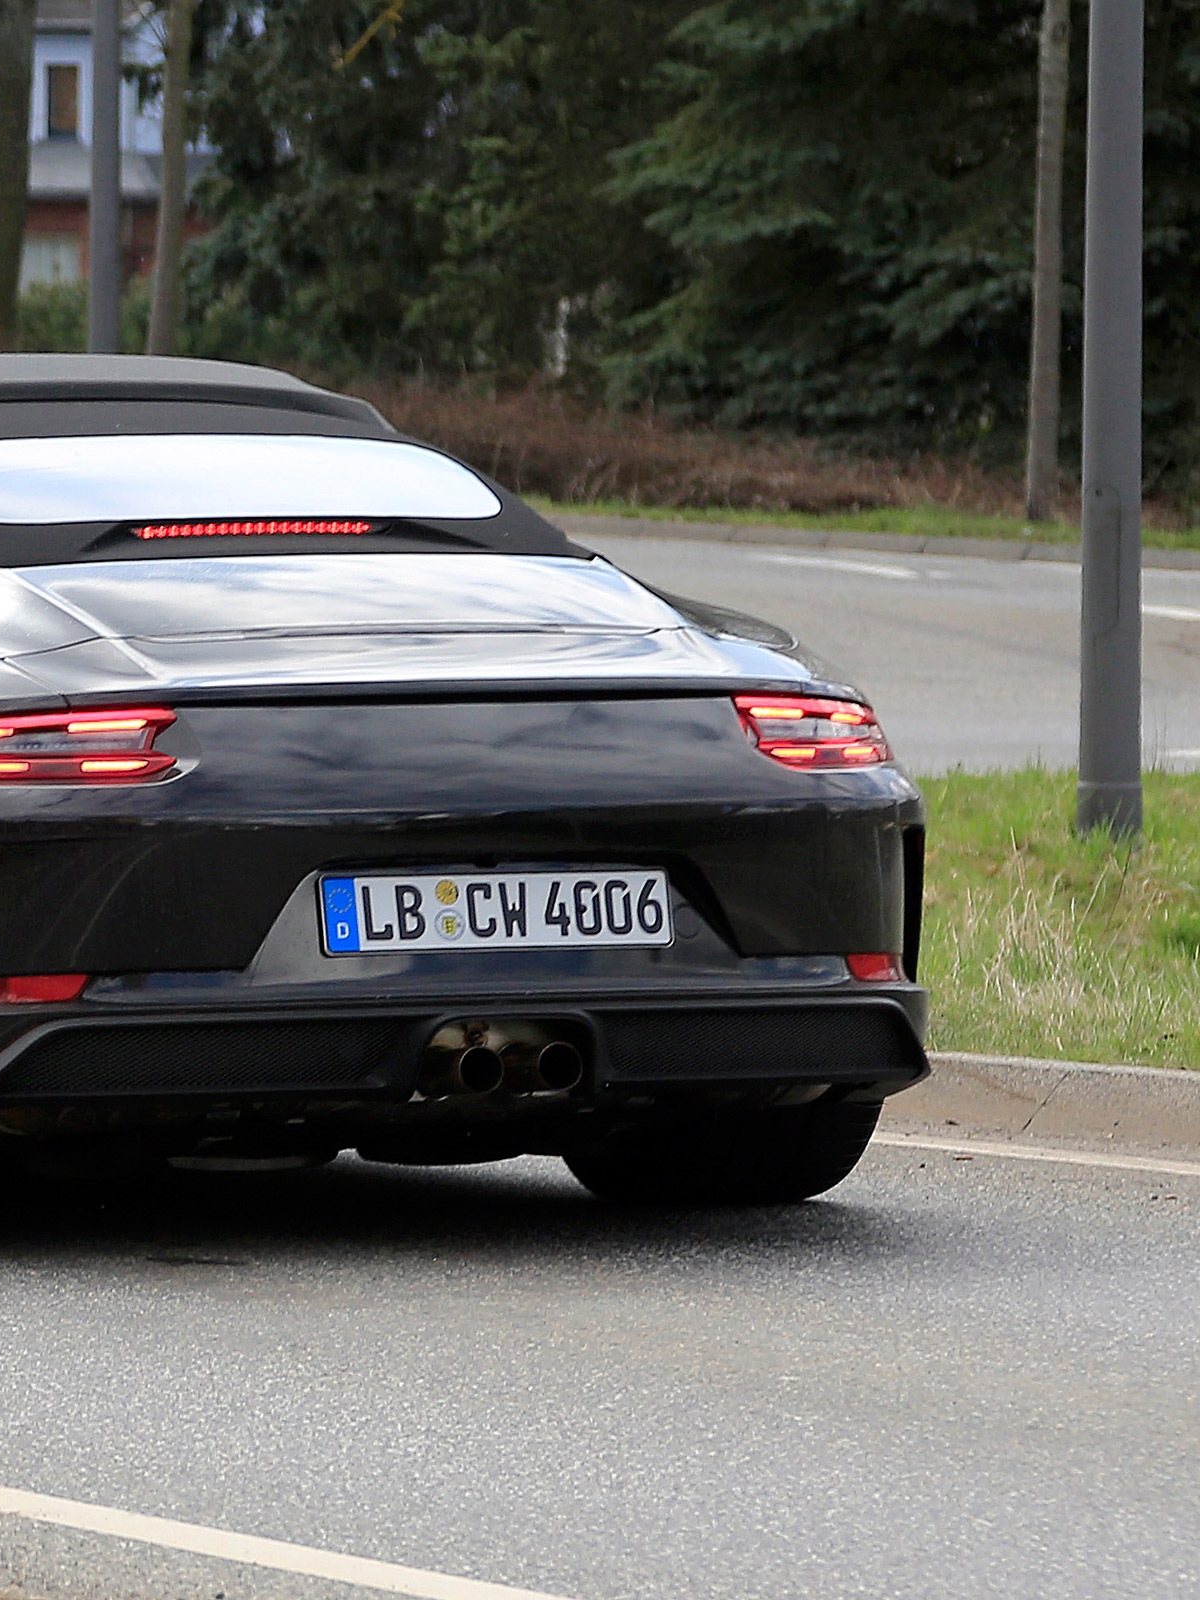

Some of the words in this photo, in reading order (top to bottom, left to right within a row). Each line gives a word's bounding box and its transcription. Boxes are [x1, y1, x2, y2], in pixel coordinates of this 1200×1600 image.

[360, 884, 426, 941] LB
[466, 881, 528, 939] CW
[544, 878, 664, 937] 4006
[336, 922, 350, 939] D
